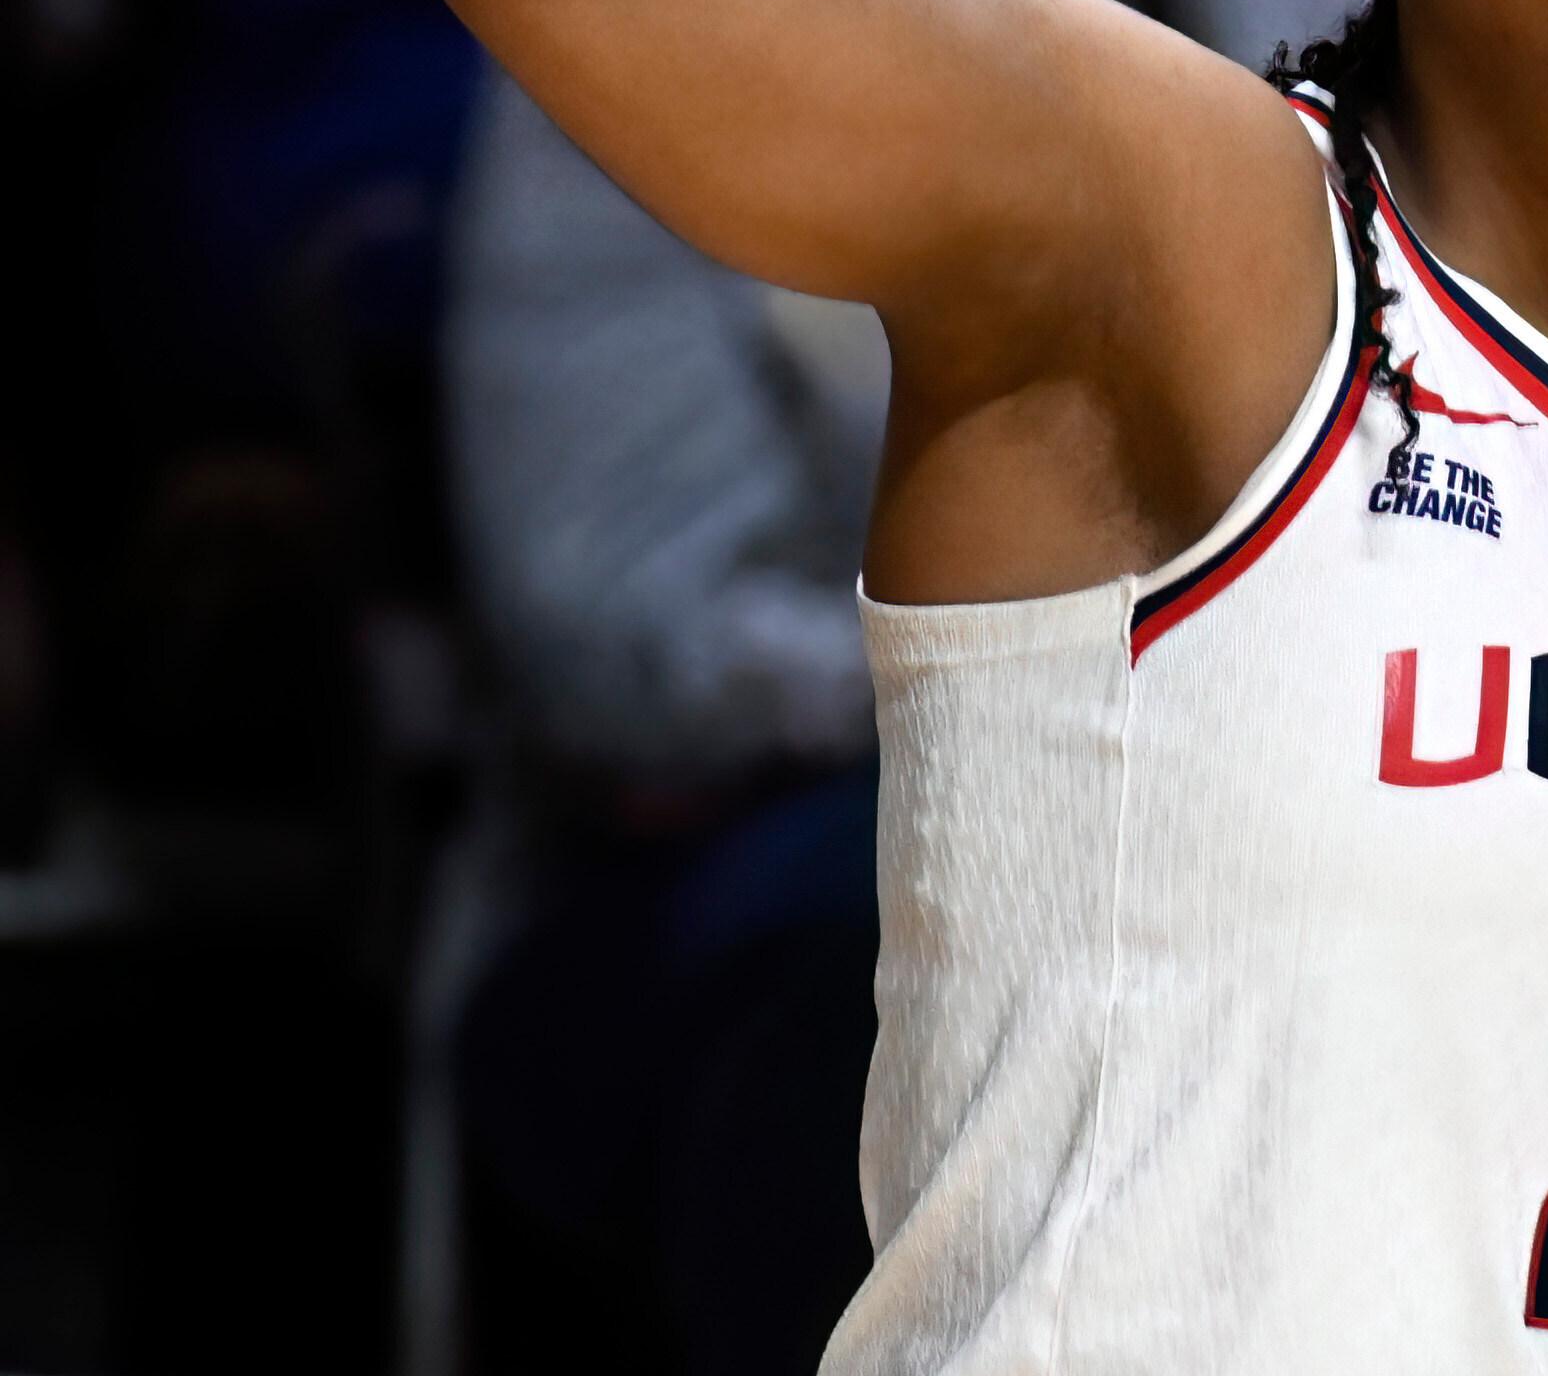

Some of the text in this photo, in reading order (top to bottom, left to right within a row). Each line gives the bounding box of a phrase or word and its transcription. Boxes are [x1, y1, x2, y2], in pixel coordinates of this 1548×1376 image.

[1390, 449, 1496, 506] BE THE
[1368, 480, 1503, 540] CHANGE
